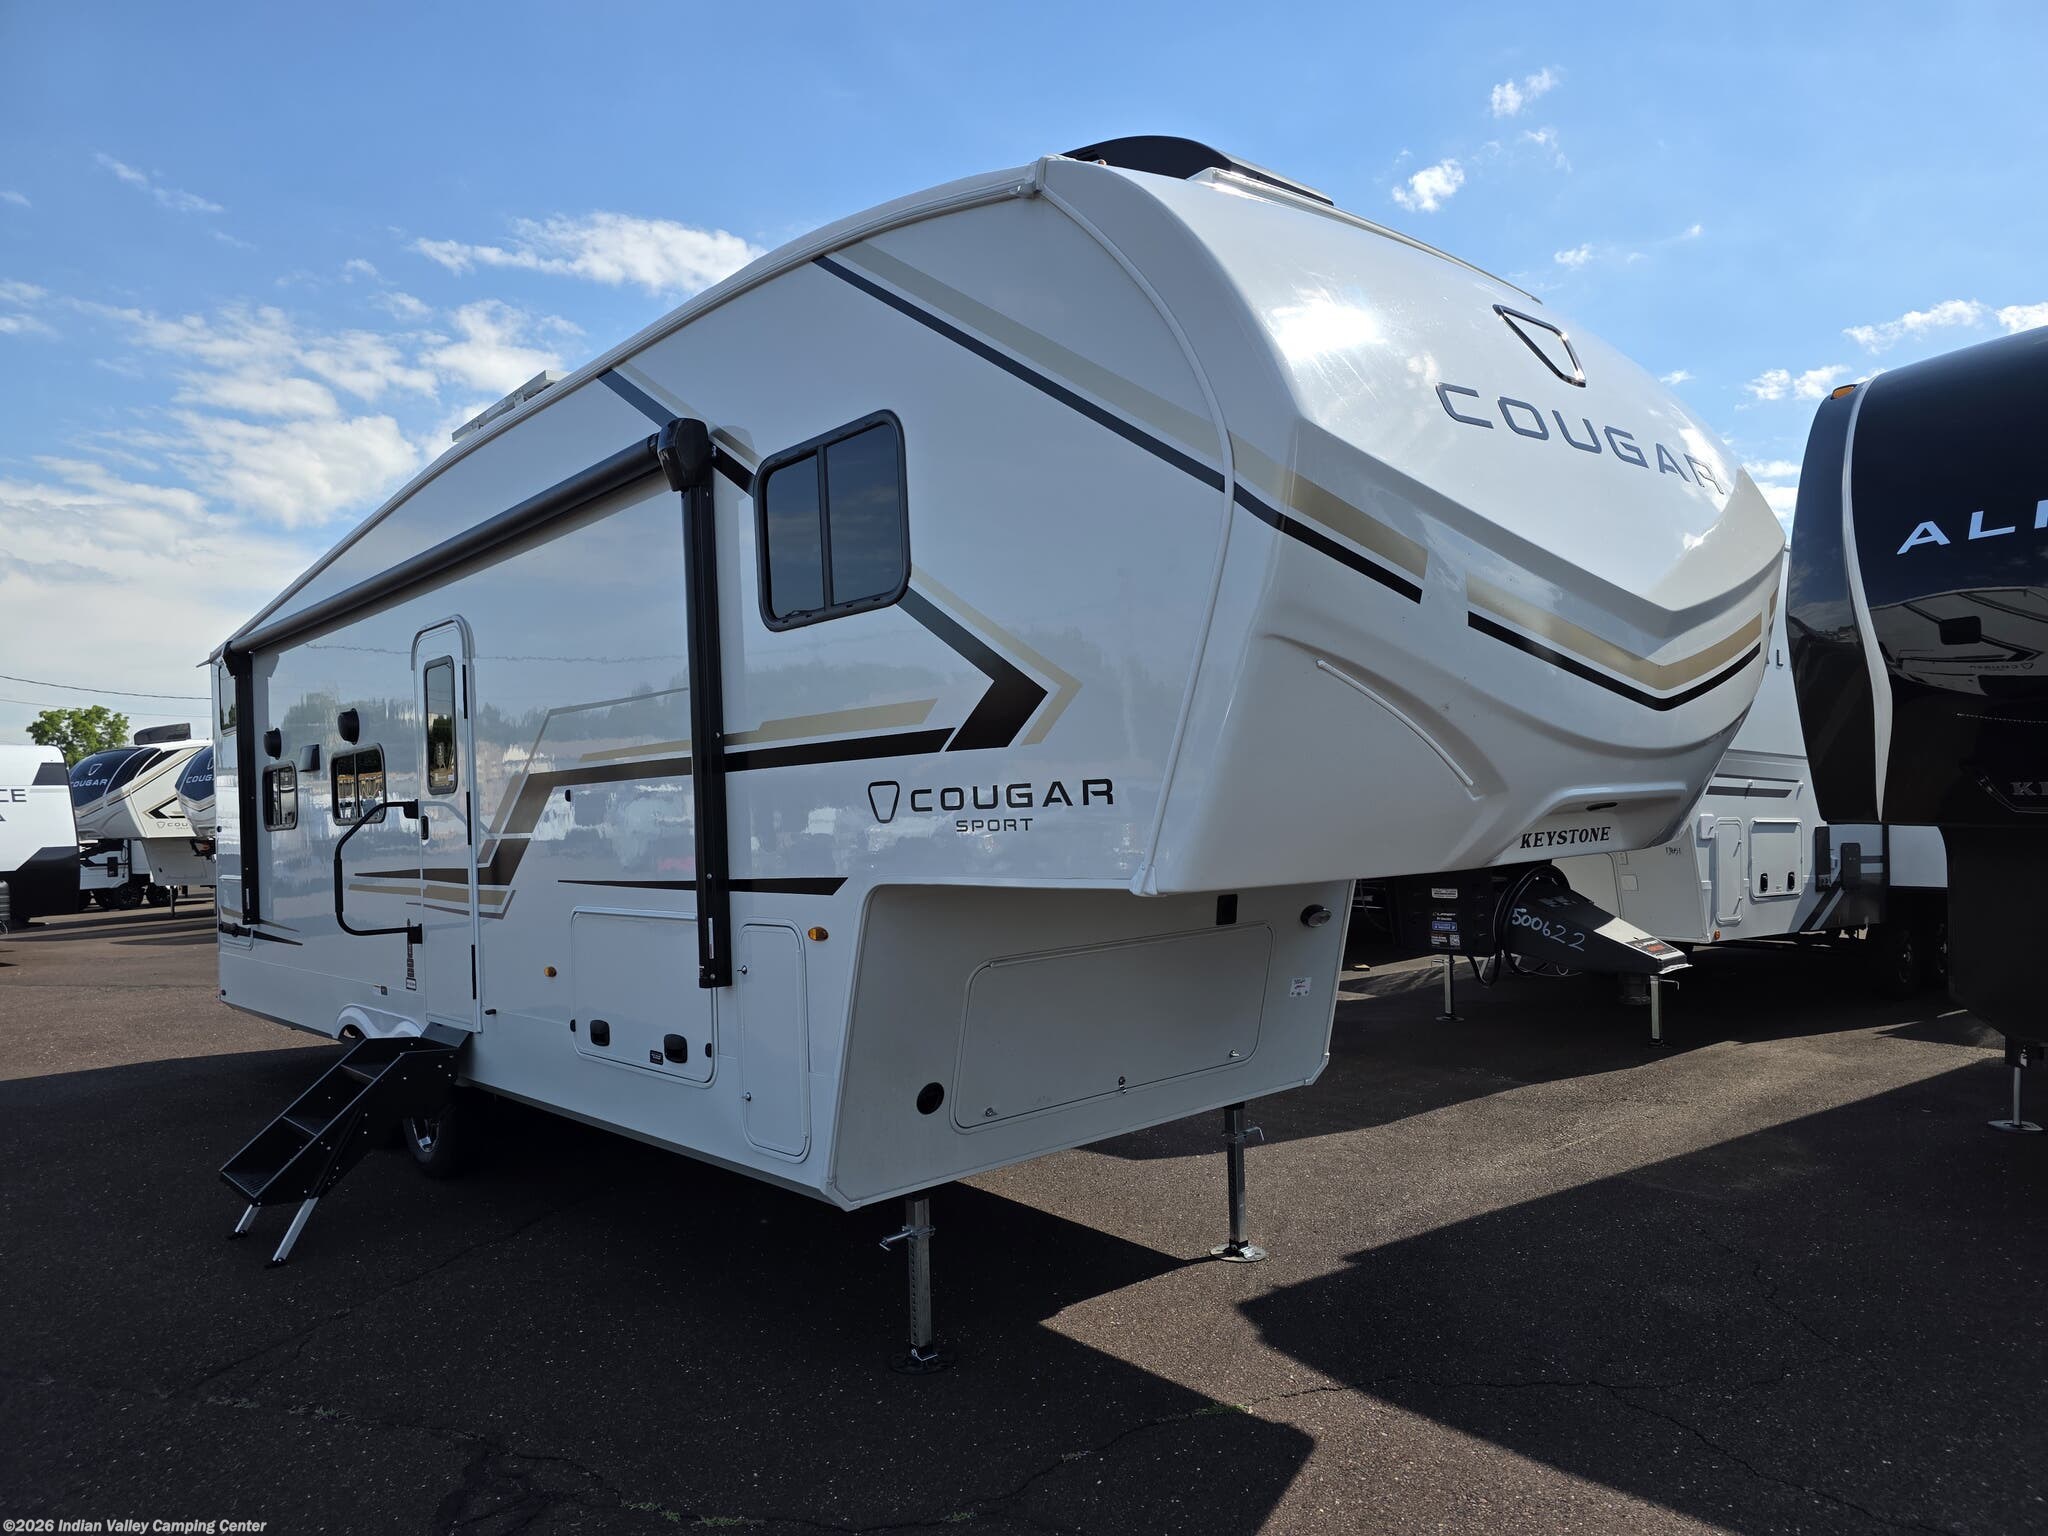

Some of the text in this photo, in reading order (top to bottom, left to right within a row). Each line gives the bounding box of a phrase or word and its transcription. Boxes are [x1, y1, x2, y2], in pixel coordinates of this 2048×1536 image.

[1435, 382, 1725, 495] COUGAR
[910, 778, 1114, 812] COUGAR
[956, 818, 1034, 832] SPORT
[1519, 826, 1611, 849] KEYSTONE
[1511, 907, 1586, 952] 500622
